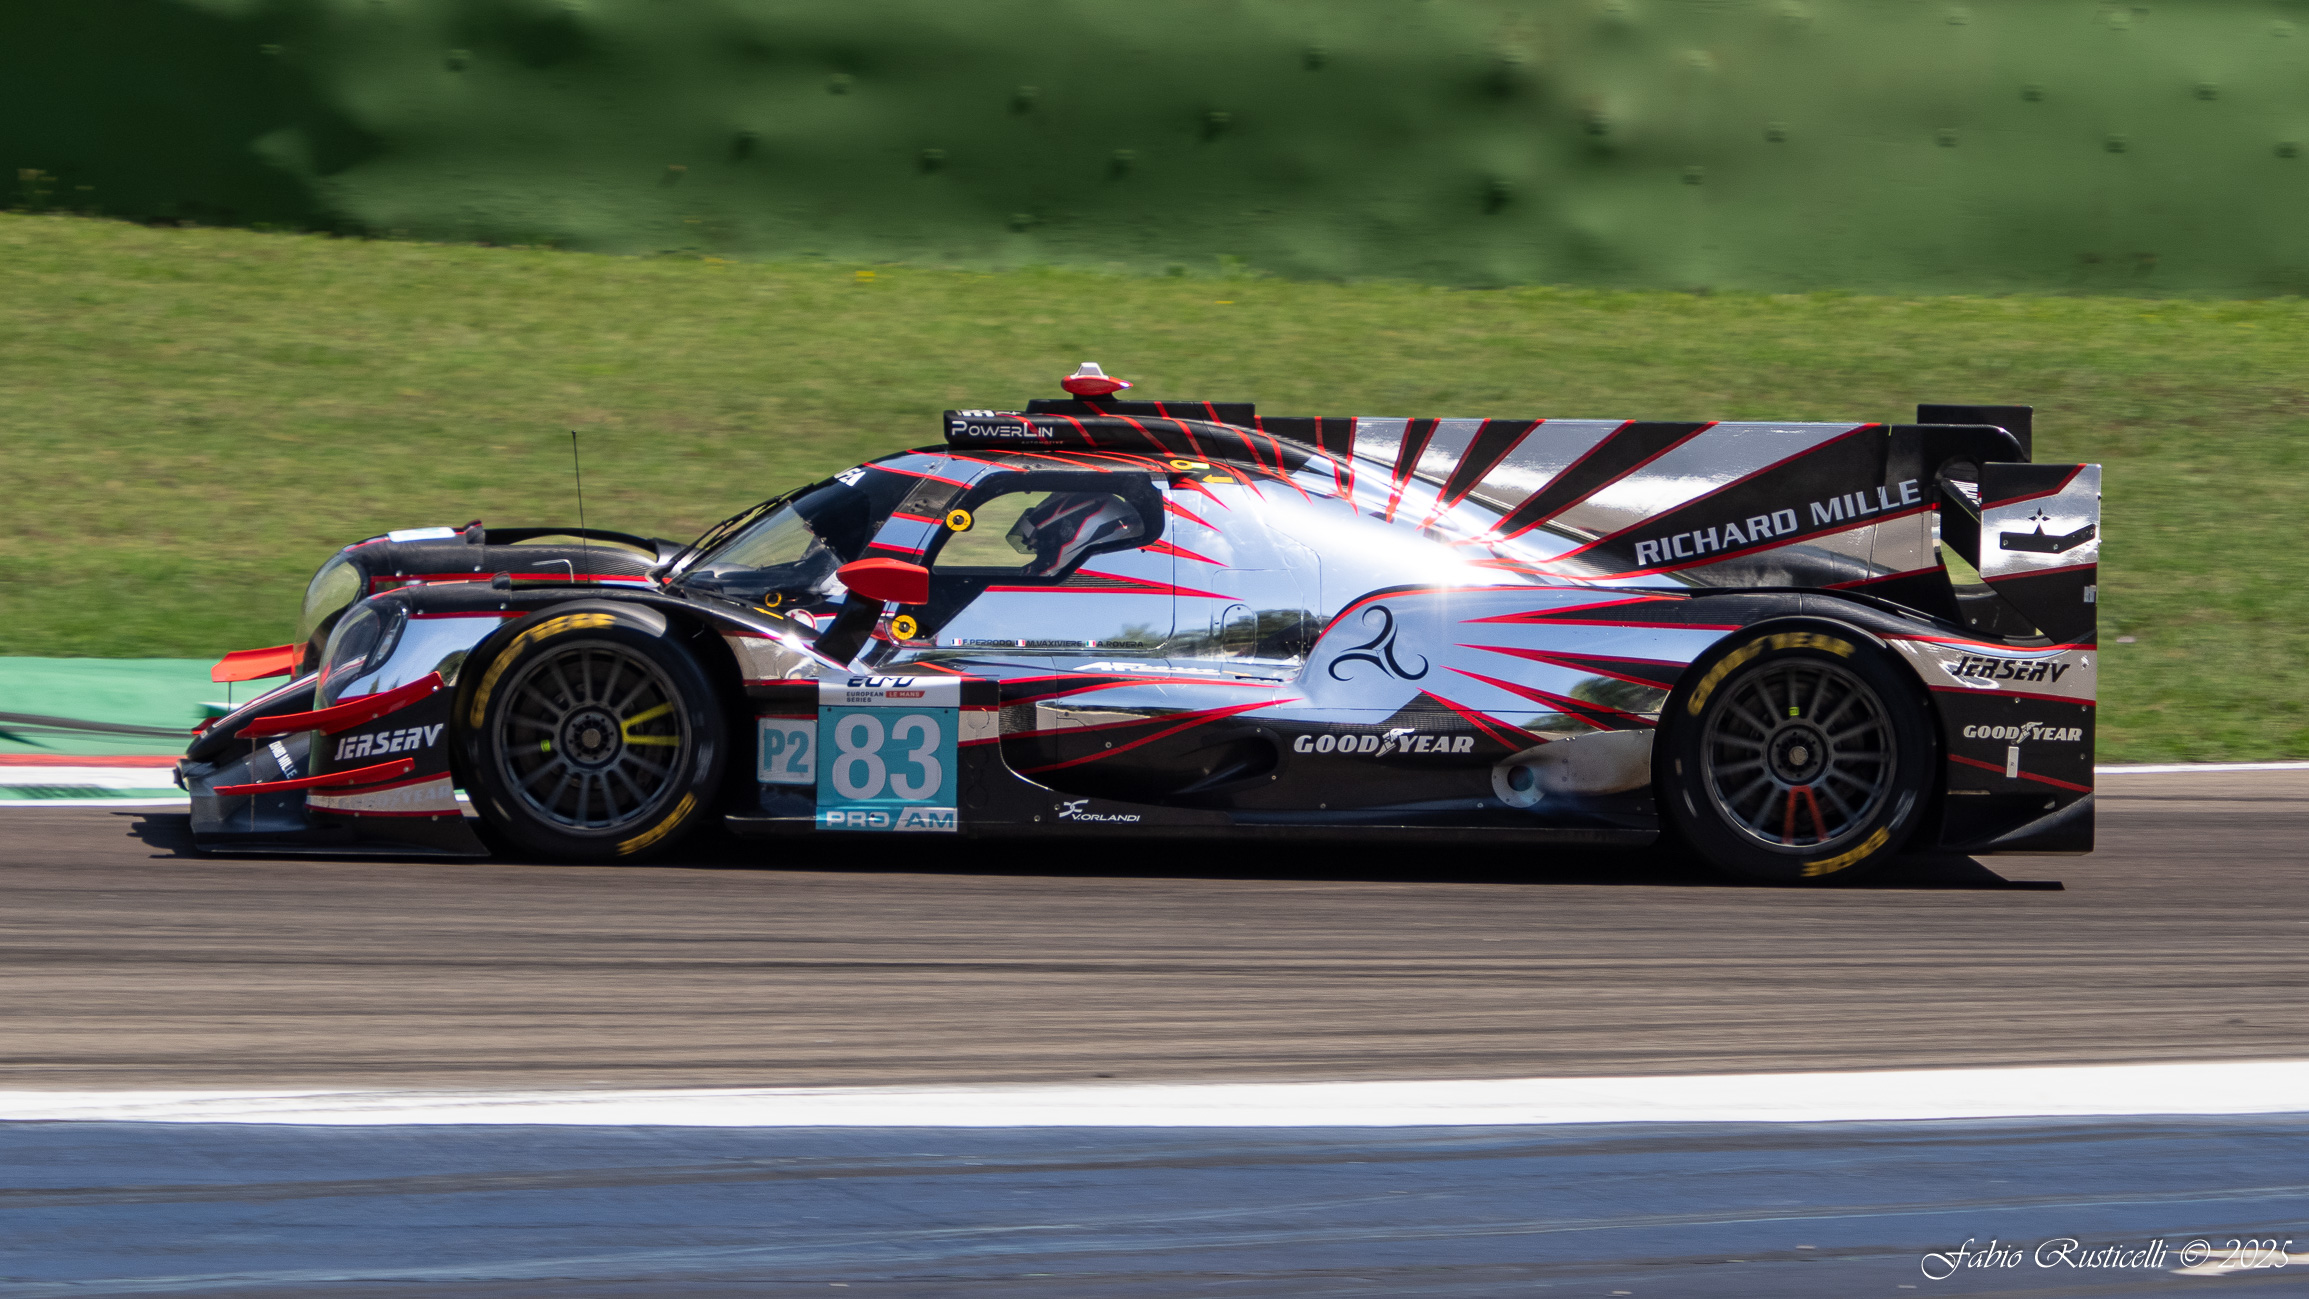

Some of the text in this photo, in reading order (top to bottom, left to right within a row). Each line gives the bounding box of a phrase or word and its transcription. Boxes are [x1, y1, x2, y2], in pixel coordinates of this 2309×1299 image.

[1635, 508, 1798, 566] RICHARD
[1810, 479, 1922, 526] MILLE
[1952, 656, 2071, 683] JERSERV
[334, 723, 445, 761] JERSERV
[1293, 734, 1475, 753] GOODYEAR
[1963, 724, 2083, 742] GOODYEAR
[763, 728, 810, 774] P2
[832, 713, 943, 801] 83
[826, 811, 954, 828] PRO AM
